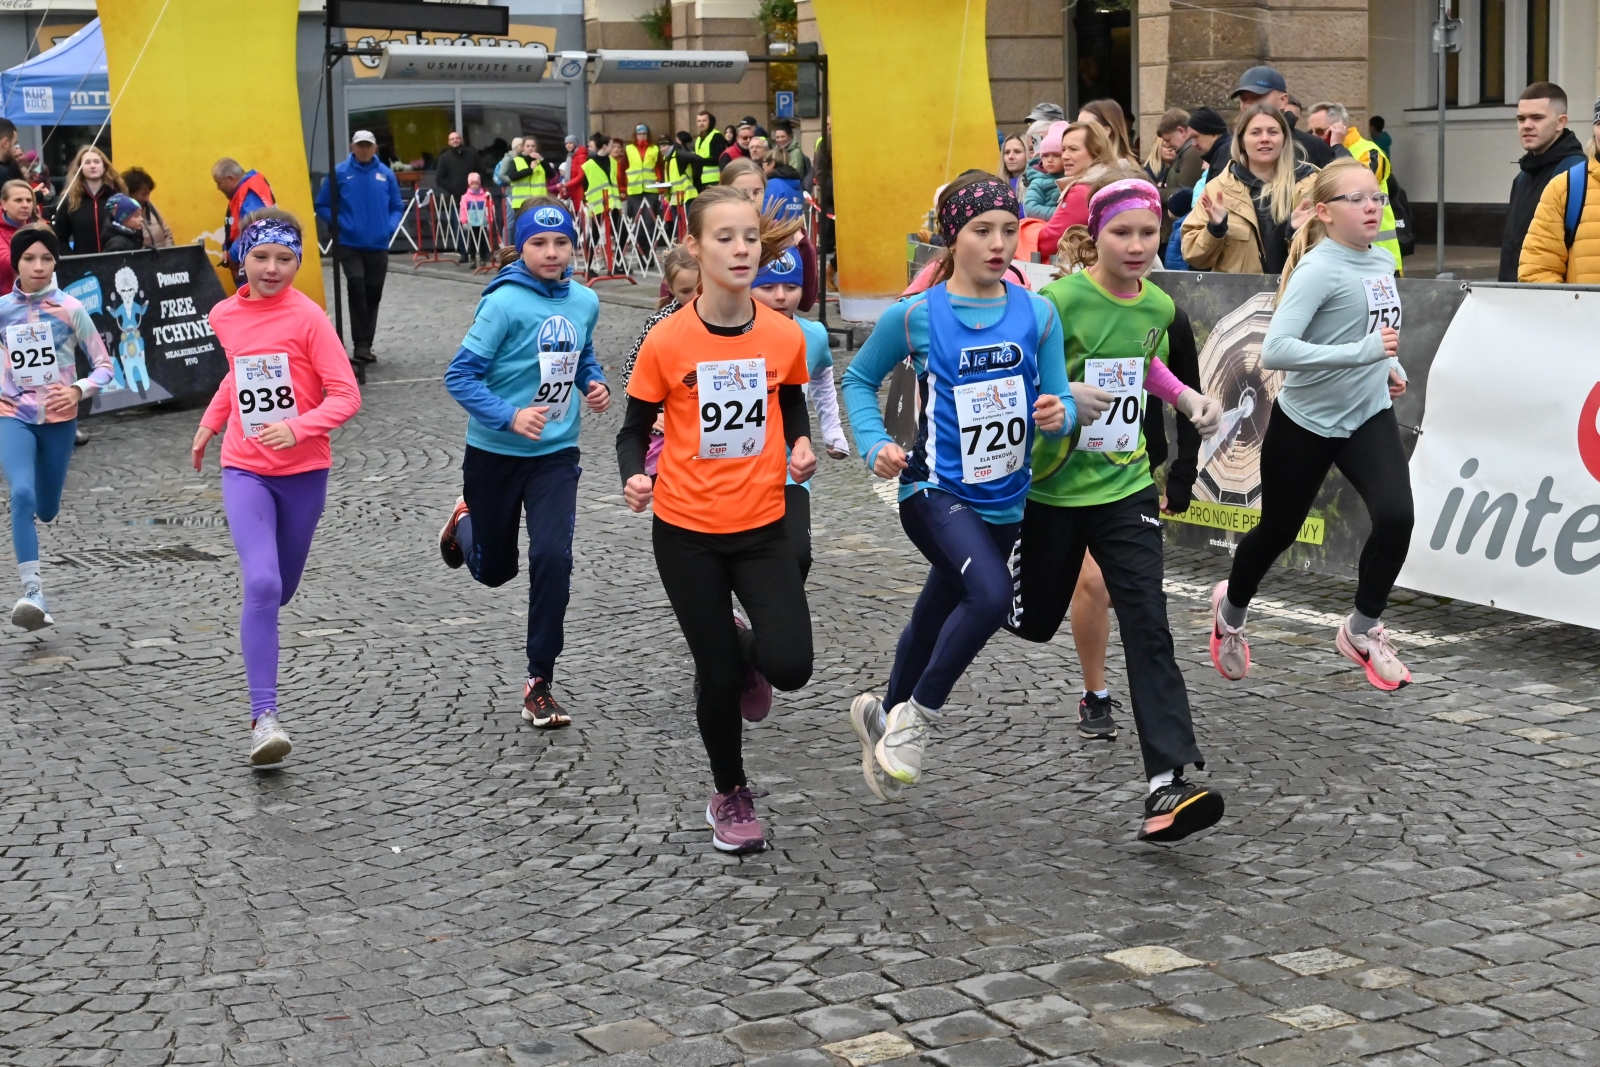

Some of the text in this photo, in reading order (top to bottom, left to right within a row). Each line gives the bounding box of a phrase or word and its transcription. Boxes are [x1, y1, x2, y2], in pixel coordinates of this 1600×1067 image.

[427, 61, 532, 72] USMÍVEJTE SE
[25, 88, 46, 99] KUP
[779, 95, 790, 110] P
[26, 99, 47, 109] KOLO
[156, 271, 190, 288] PRIMATOR
[160, 296, 197, 319] FREE
[152, 314, 216, 346] TCHYNĚ
[1369, 306, 1401, 335] 752
[11, 346, 56, 370] 925
[165, 342, 215, 359] NEALKOHOLICKÉ
[185, 356, 199, 366] PIVO
[239, 386, 295, 414] 938
[533, 381, 574, 403] 927
[701, 399, 766, 433] 924
[961, 417, 1026, 456] 720
[991, 450, 1013, 460] BEKOVÁ
[974, 469, 992, 478] CUP
[1190, 505, 1210, 523] PRO
[1212, 508, 1239, 530] NOVÉ
